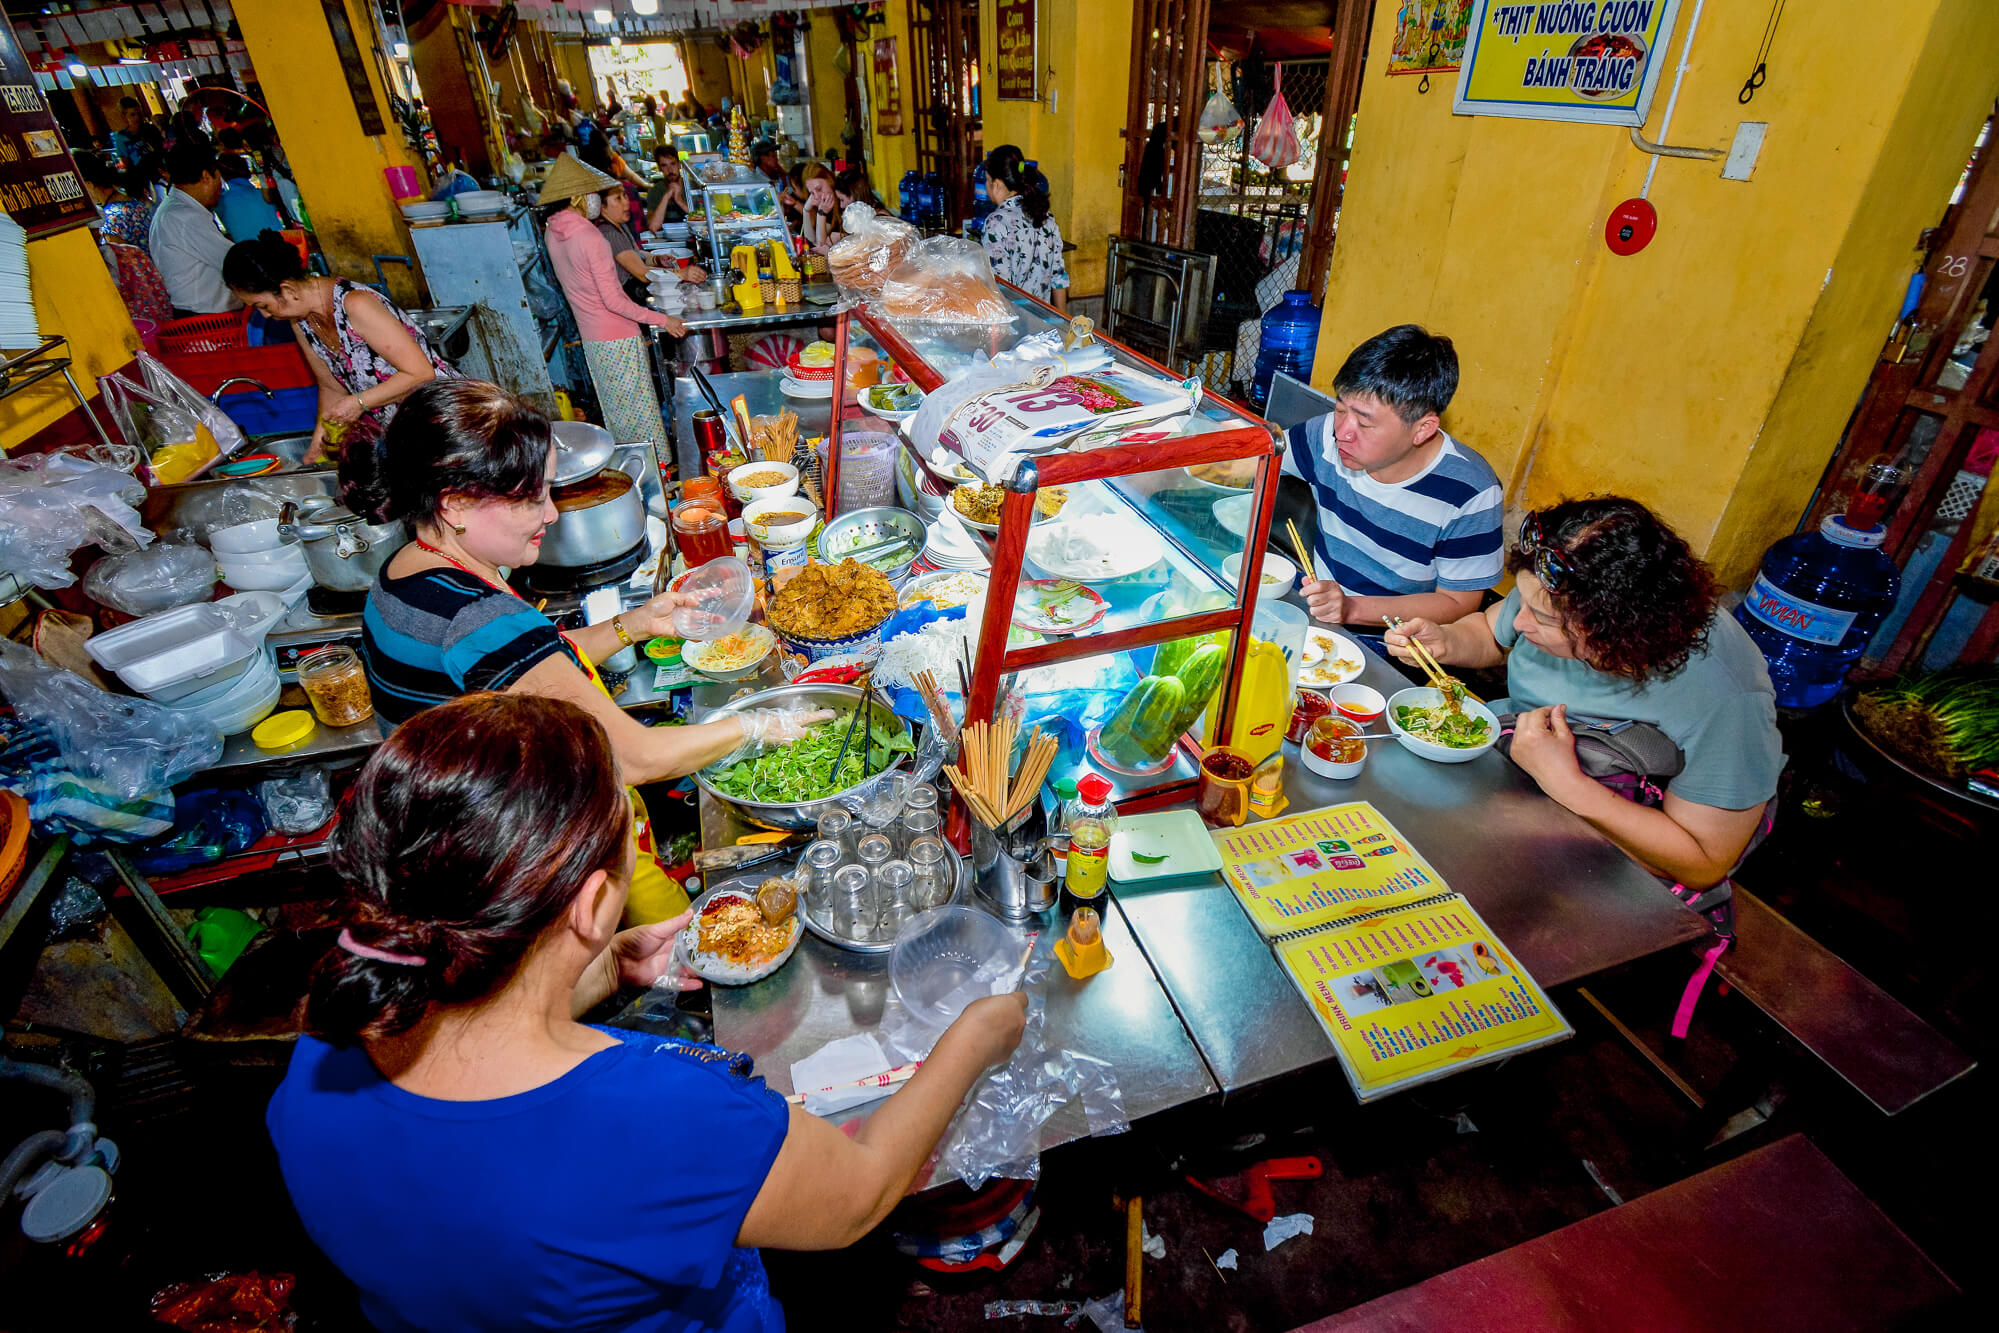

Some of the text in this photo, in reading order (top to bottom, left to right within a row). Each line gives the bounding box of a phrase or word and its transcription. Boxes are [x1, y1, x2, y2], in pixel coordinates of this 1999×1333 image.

[1523, 48, 1635, 89] BÁNH TRÁNG
[1936, 255, 1969, 278] 28
[781, 550, 805, 566] Ensure
[1759, 592, 1816, 631] VIVIAN
[1315, 980, 1352, 1030] DRINK MENU
